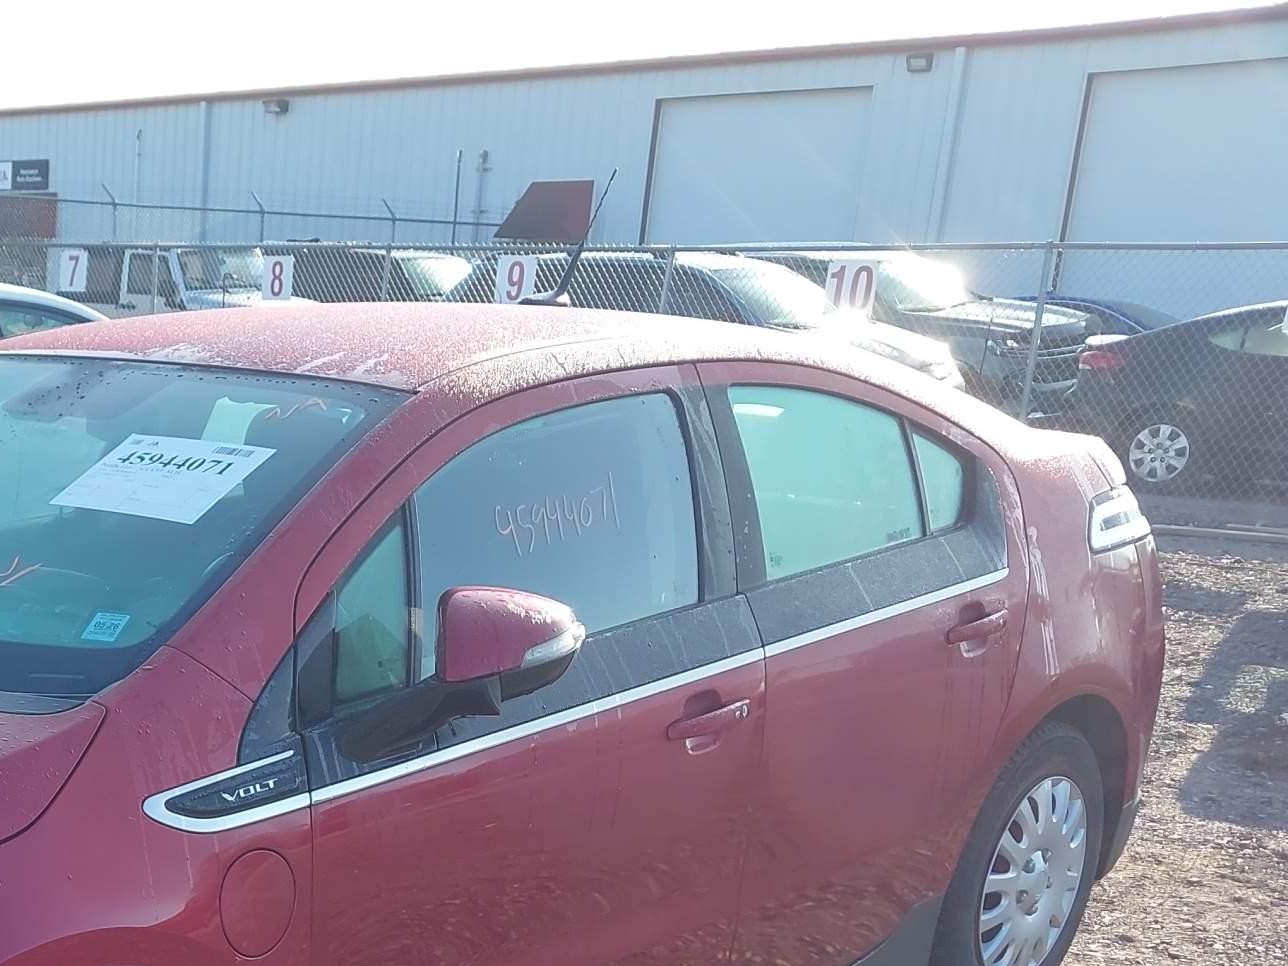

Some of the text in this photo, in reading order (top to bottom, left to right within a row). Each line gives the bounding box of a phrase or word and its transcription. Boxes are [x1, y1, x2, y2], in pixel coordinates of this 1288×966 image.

[68, 255, 80, 288] 7
[270, 260, 284, 296] 8
[506, 260, 525, 301] 9
[830, 264, 874, 310] 10
[117, 450, 235, 476] 45944071
[220, 778, 279, 802] VOLT
